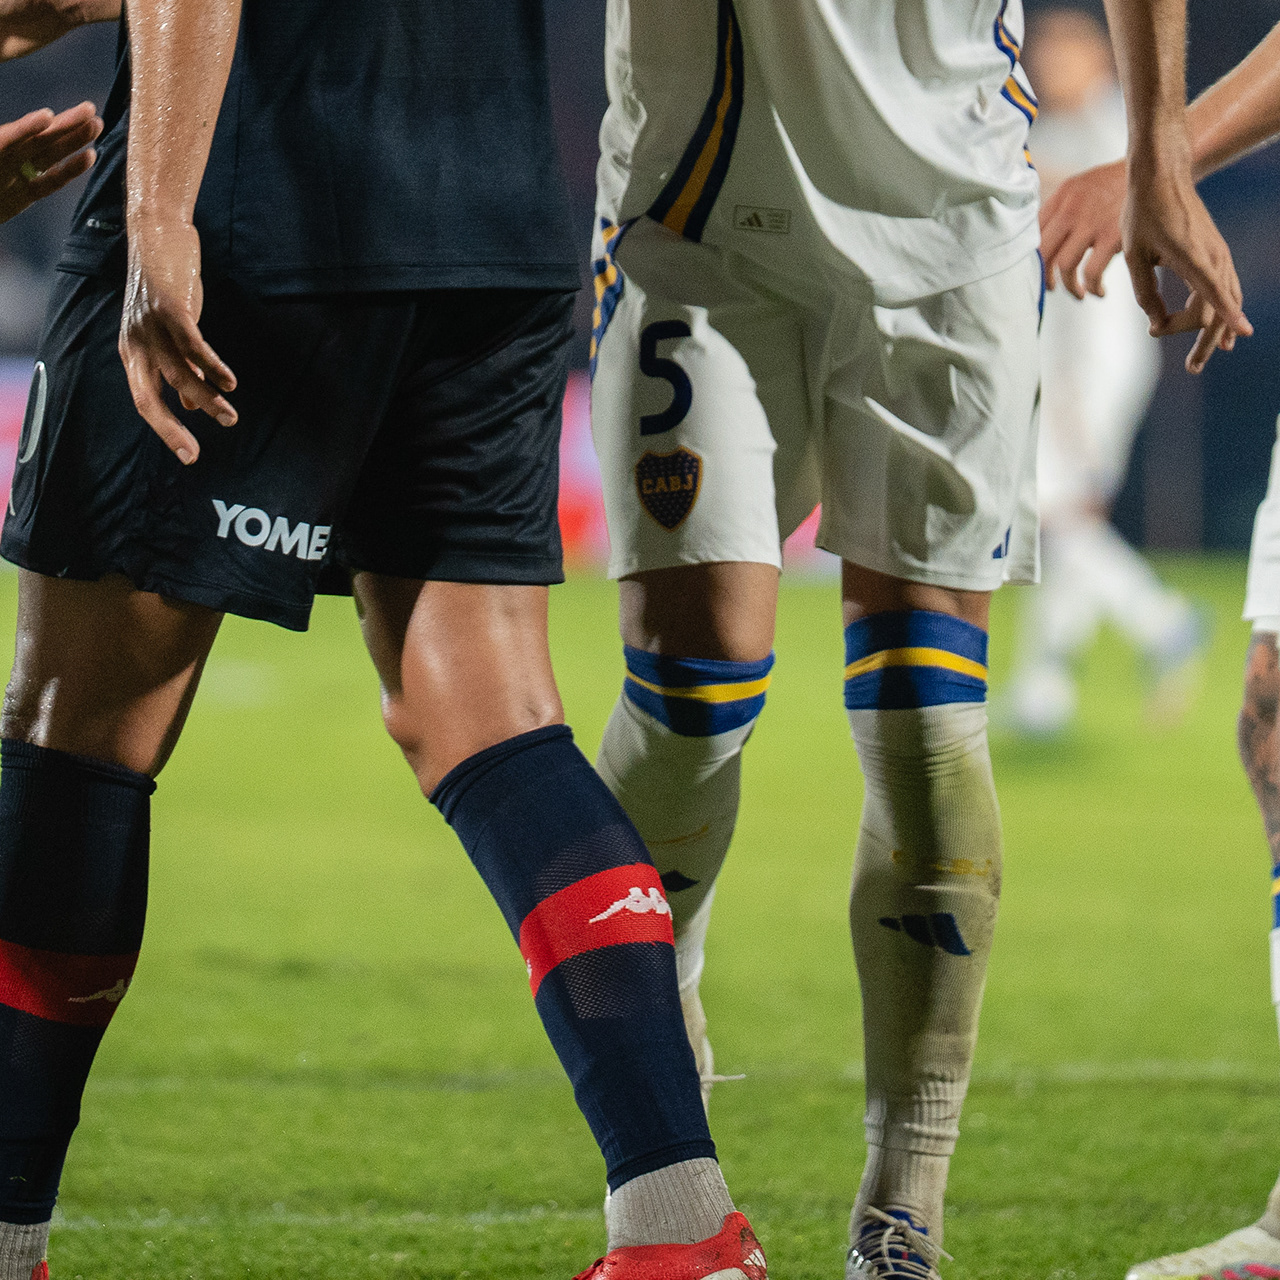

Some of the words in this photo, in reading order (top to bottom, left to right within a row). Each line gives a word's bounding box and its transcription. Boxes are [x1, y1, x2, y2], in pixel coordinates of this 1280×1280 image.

[639, 319, 692, 436] 5
[642, 474, 694, 495] CABJ
[211, 499, 333, 560] YOME
